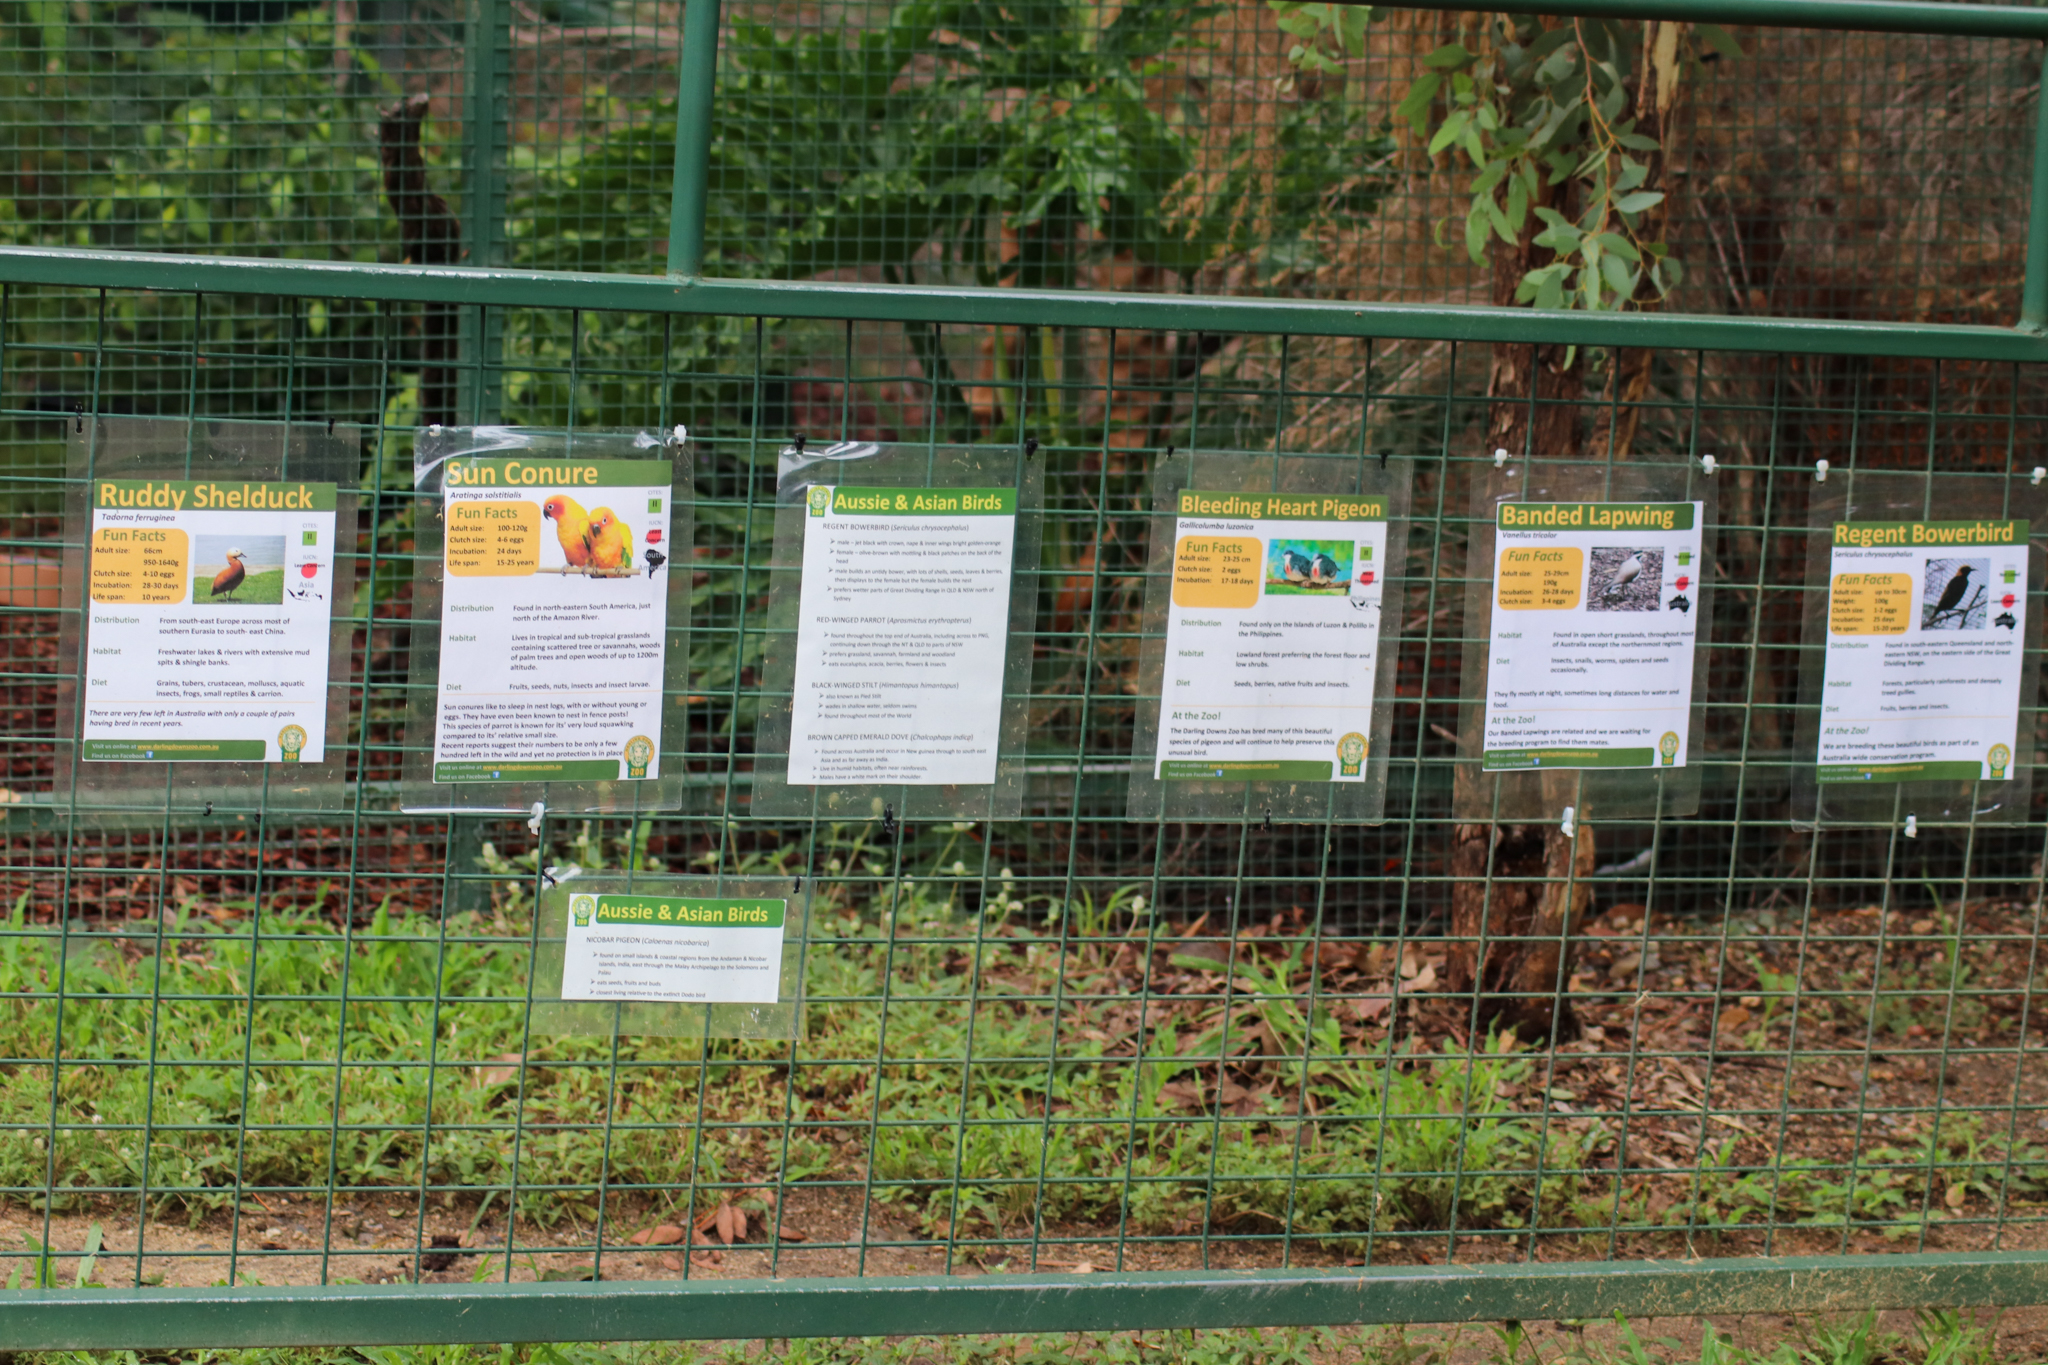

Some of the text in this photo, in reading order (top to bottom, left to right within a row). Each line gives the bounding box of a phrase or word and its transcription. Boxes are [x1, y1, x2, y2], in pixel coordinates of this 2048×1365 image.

[446, 462, 598, 485] Sun Conure
[100, 483, 313, 511] Ruddy Shelduck
[450, 492, 484, 500] Aratinga
[834, 494, 1002, 510] Aussie & Asian Birds
[1181, 495, 1381, 521] Bleeding Heart Pigeon
[102, 512, 176, 523] Tadorna ferruginea
[457, 508, 518, 518] Fun Facts
[1501, 503, 1675, 529] Banded Lapwing
[498, 524, 528, 533] 100-120g
[890, 524, 921, 532] (Sericulus
[1179, 521, 1225, 530] Gallicolumba
[104, 530, 166, 542] Fun Facts
[1502, 530, 1559, 539] Vanellus tricolor
[1835, 522, 2014, 546] Regent Bowerbird
[1186, 542, 1242, 553] Fun Facts
[1508, 551, 1564, 561] Fun Facts
[143, 559, 180, 568] 950-1640g
[1839, 575, 1892, 584] Fun Facts
[163, 582, 180, 590] days
[298, 581, 315, 590] Asia
[94, 616, 140, 624] Distribution
[1180, 619, 1222, 627] Distribution
[1171, 711, 1222, 720] At the Zoo!
[1502, 716, 1517, 724] the
[1517, 715, 1536, 724] Zoo!
[1835, 727, 1850, 735] the
[1850, 726, 1870, 735] Zoo!
[910, 733, 952, 742] (Chalcophaps
[283, 751, 298, 761] ZOO
[630, 767, 645, 777] ZOO
[1341, 764, 1359, 775] ZOO
[598, 903, 768, 922] Aussie & Asian Birds
[674, 939, 710, 947] nicobarica)
